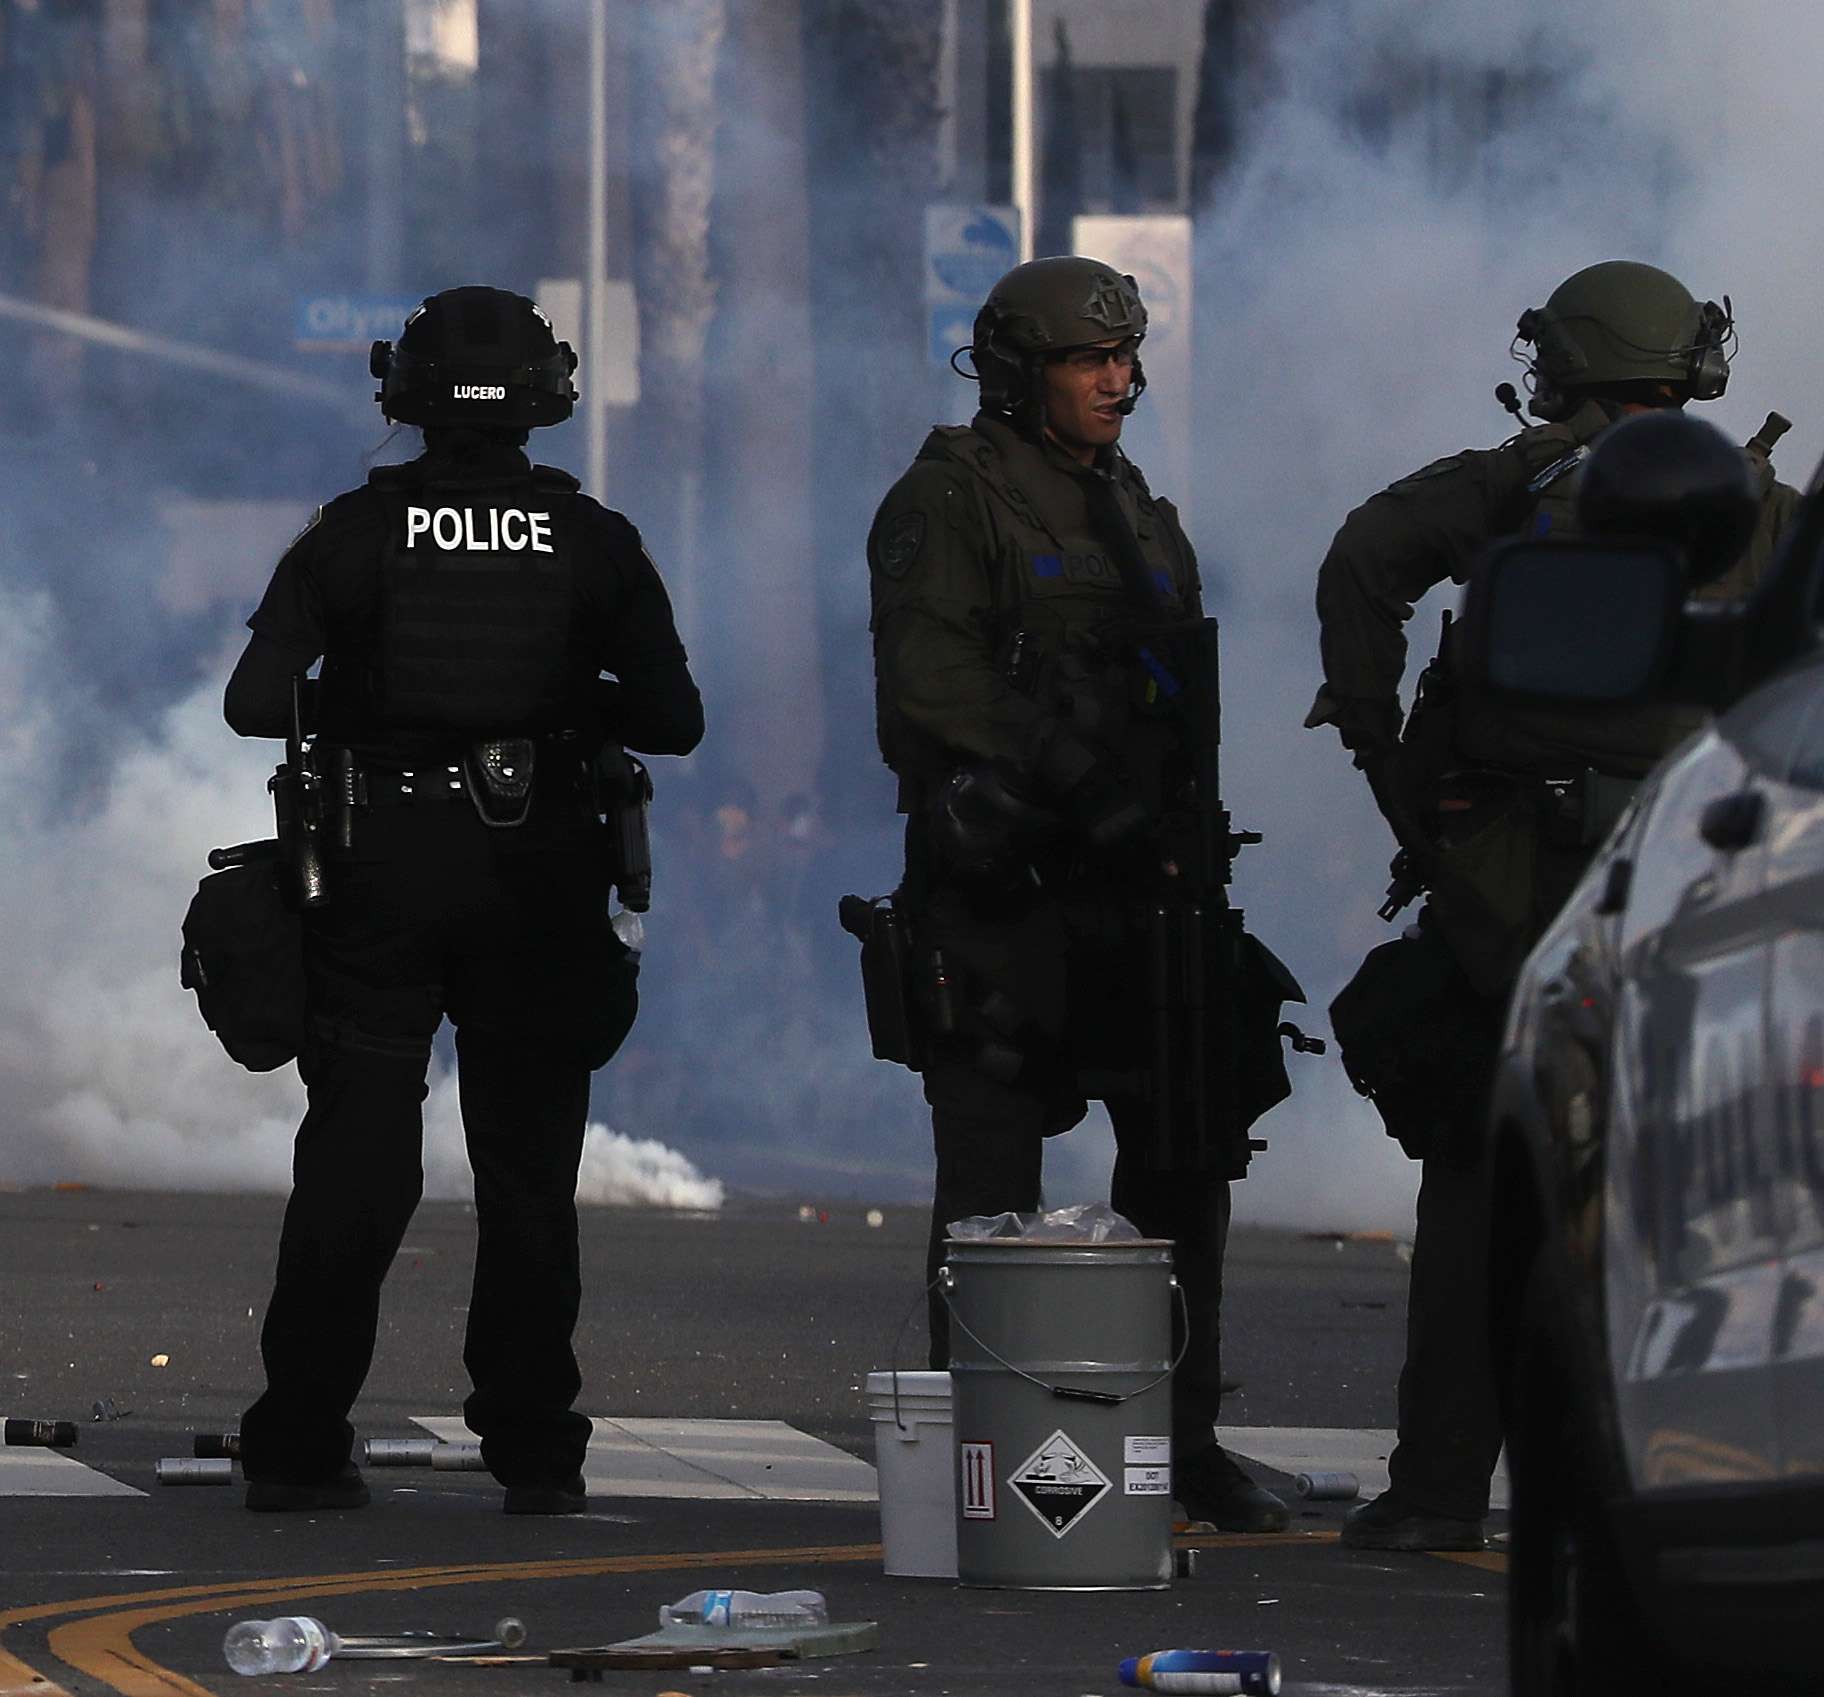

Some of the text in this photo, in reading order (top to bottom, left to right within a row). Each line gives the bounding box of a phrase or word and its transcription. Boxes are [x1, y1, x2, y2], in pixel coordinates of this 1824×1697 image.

[308, 299, 406, 336] Olym
[453, 385, 506, 400] LUCERO
[406, 506, 554, 553] POLICE
[1034, 1485, 1083, 1496] CORROSIVE
[1055, 1515, 1063, 1526] 8
